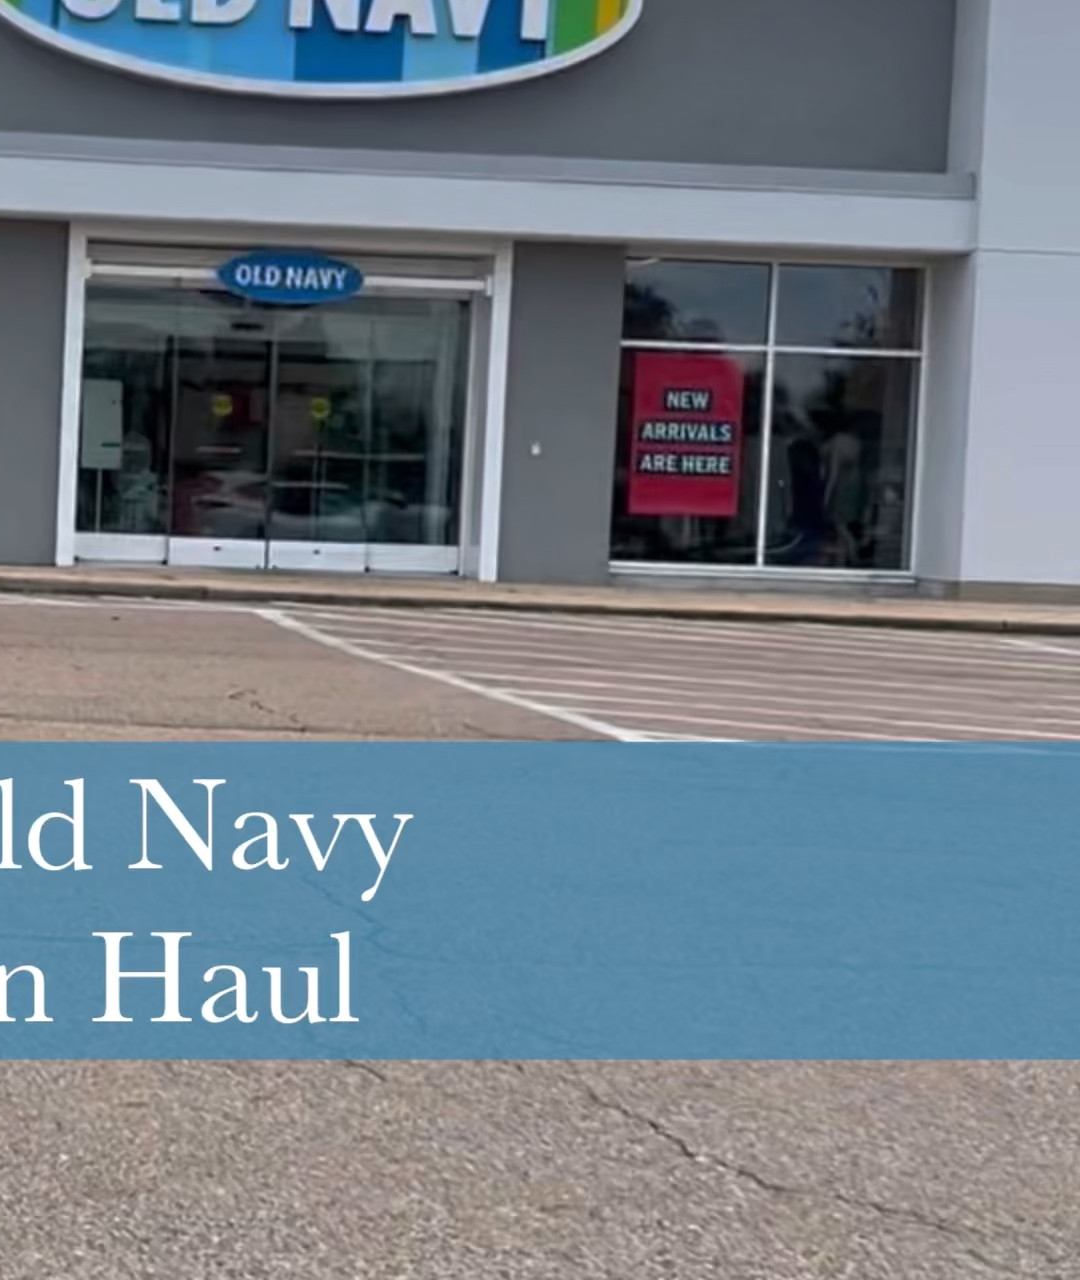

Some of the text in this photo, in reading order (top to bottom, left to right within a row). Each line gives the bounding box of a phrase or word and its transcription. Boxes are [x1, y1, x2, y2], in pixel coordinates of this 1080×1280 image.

[234, 264, 347, 289] OLD NAVY
[666, 391, 709, 409] NEW
[641, 423, 732, 442] ARRIVALS
[640, 454, 730, 474] ARE HERE
